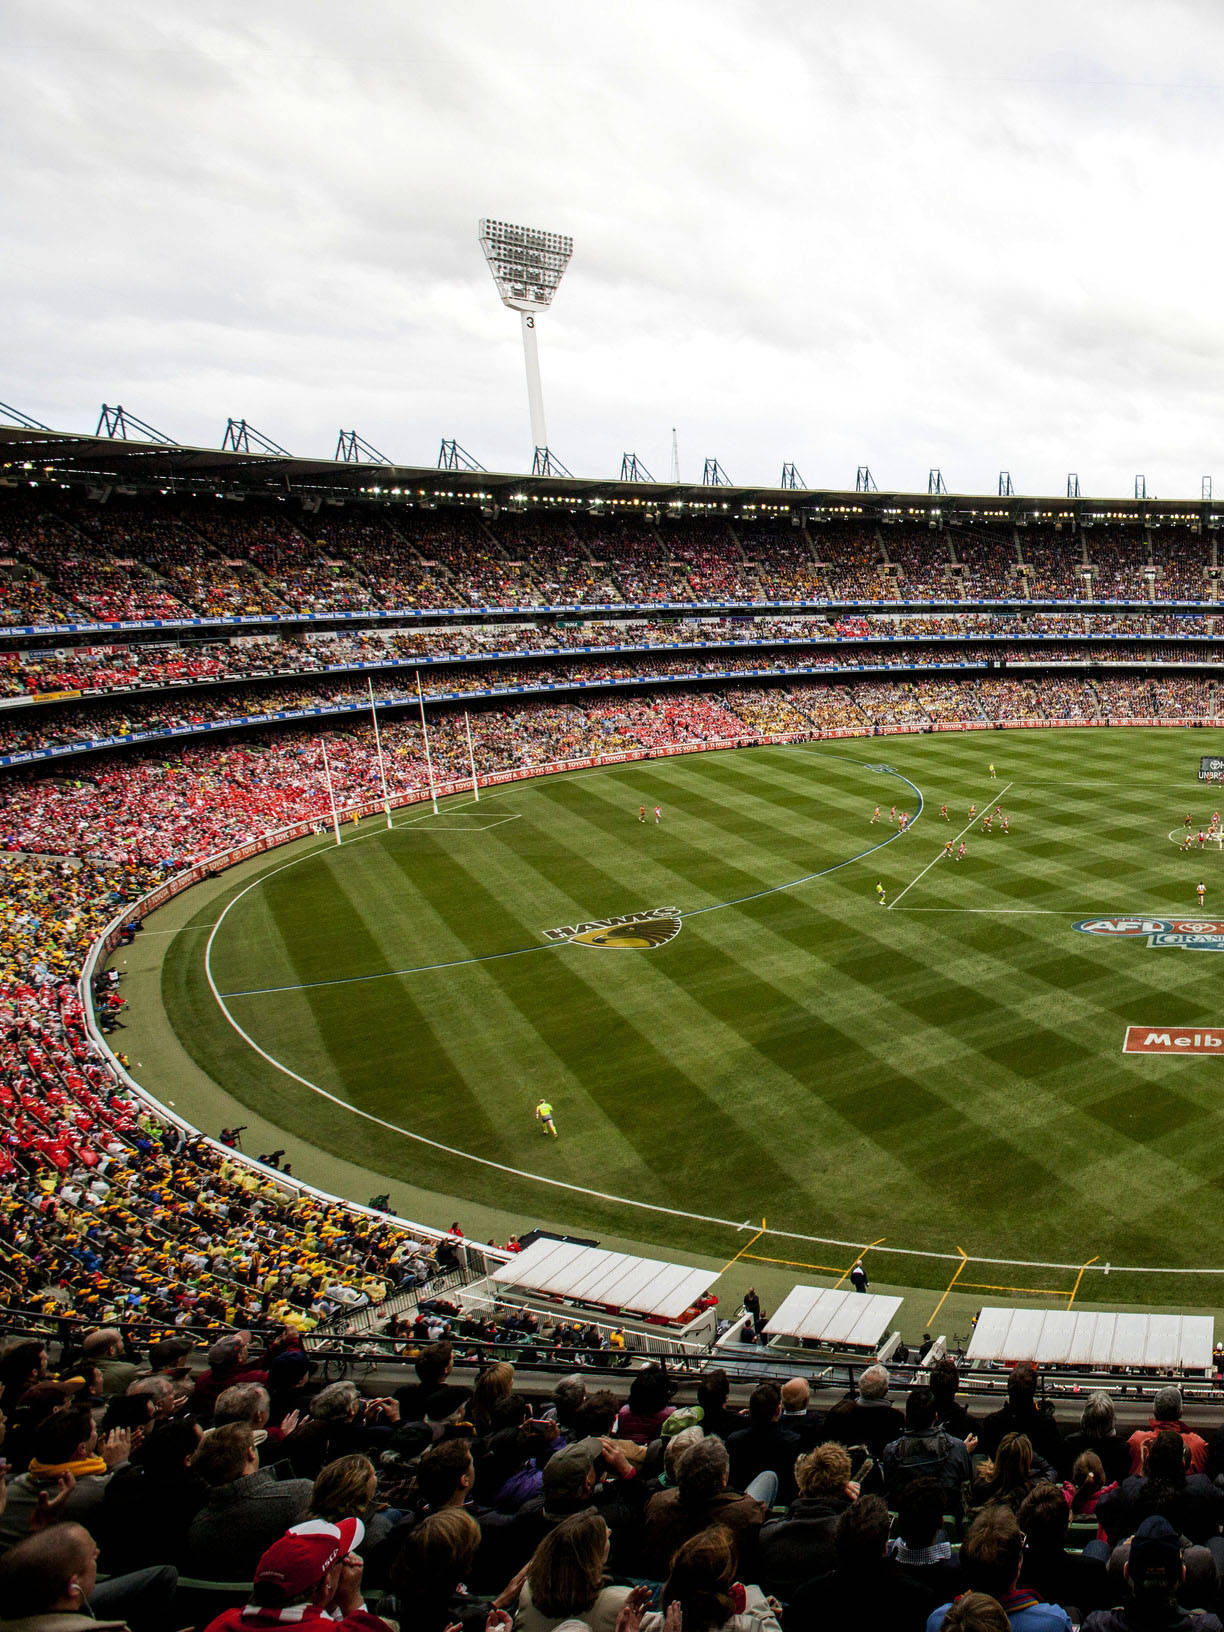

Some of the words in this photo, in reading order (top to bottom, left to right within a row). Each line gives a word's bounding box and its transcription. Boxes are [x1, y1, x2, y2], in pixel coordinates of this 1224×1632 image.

[526, 316, 535, 328] 3
[91, 646, 113, 655] PSW
[542, 906, 682, 941] HAWKS
[1087, 920, 1164, 933] AFL
